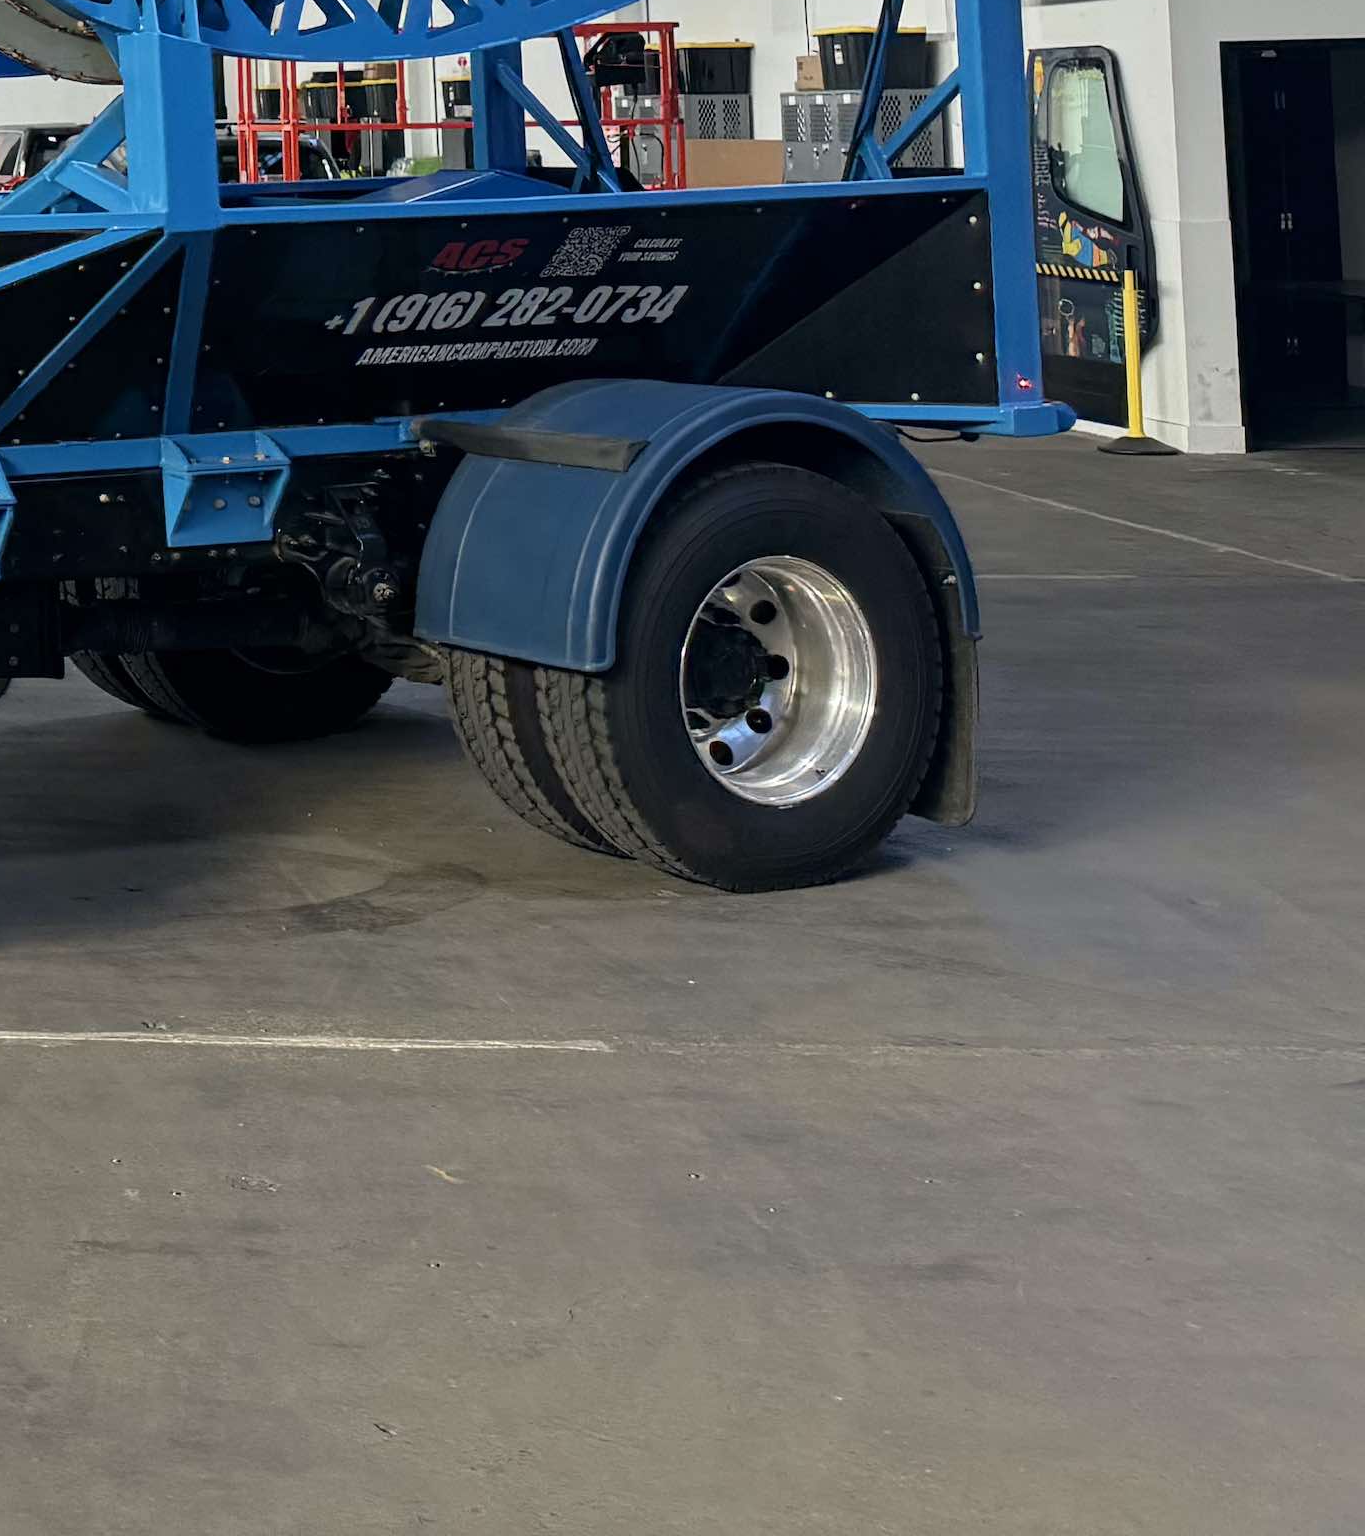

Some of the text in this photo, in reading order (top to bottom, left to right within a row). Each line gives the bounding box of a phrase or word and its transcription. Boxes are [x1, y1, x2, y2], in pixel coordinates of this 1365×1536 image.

[432, 238, 530, 271] ACS
[325, 285, 689, 335] +1 (916) 282-0734
